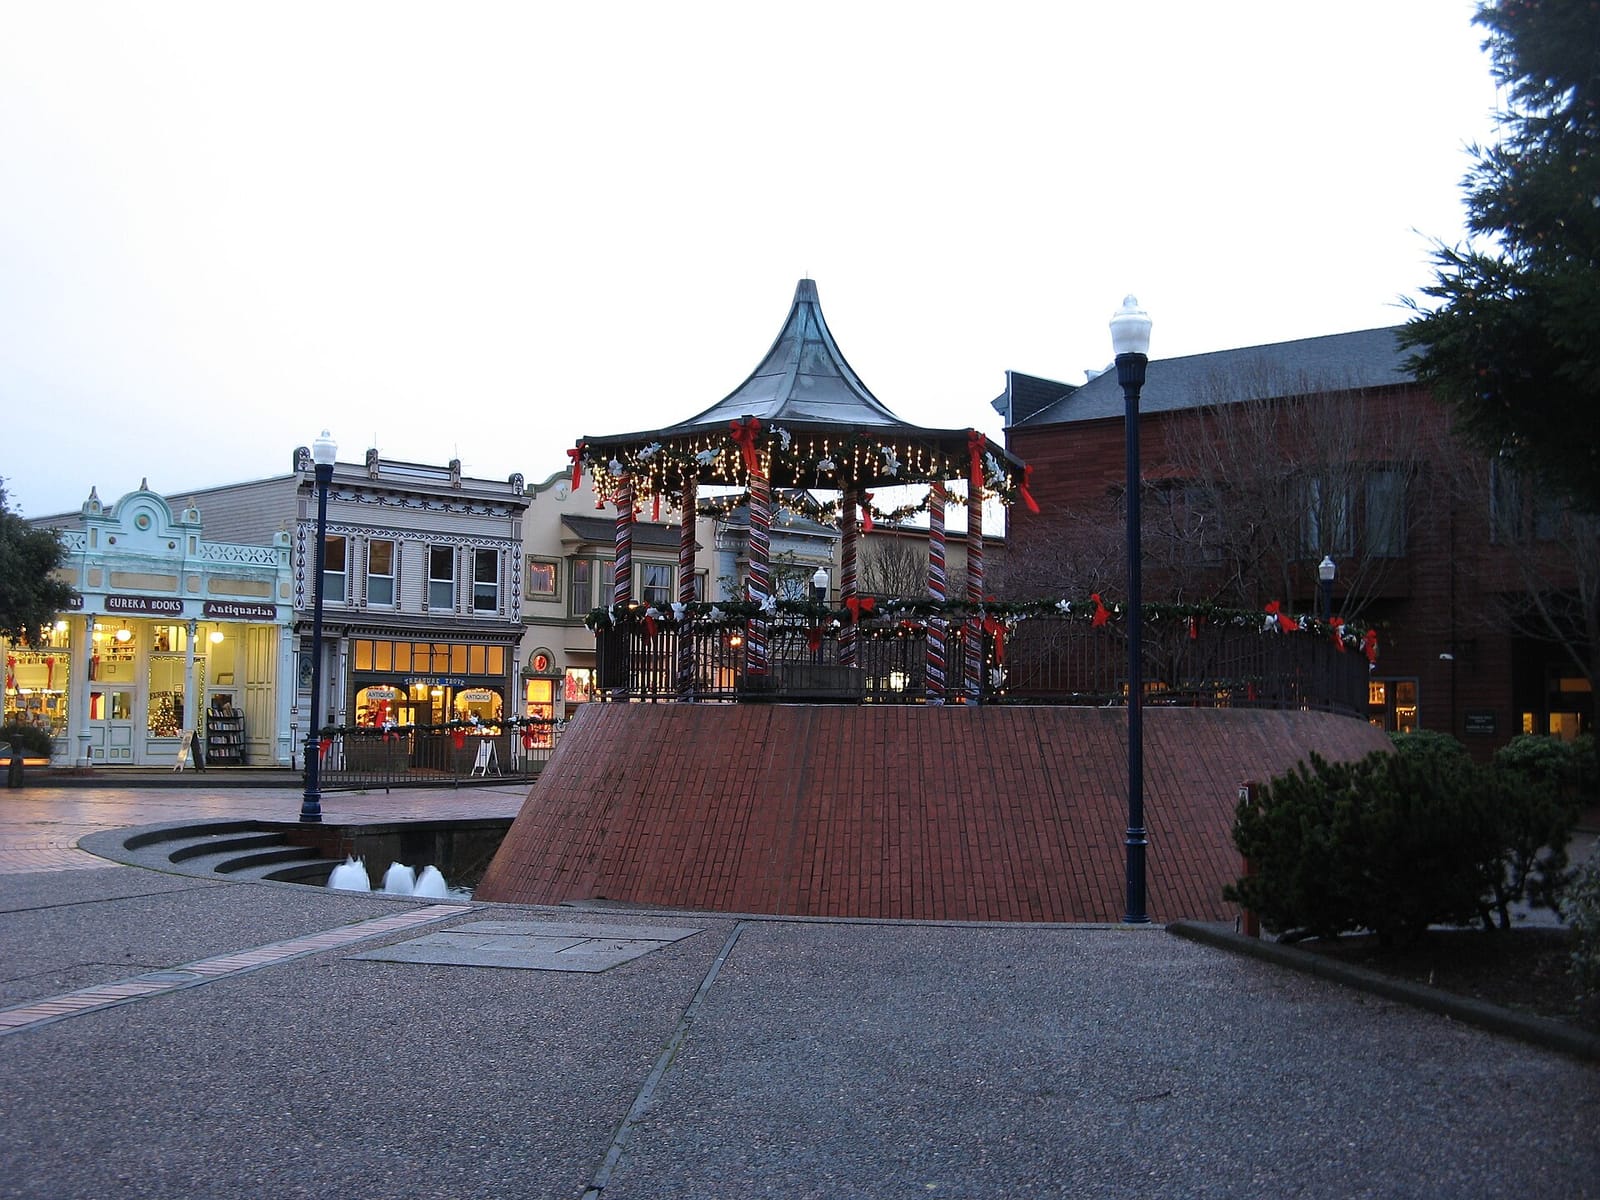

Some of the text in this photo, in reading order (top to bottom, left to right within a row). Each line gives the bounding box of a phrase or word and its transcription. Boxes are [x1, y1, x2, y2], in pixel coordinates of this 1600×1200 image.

[109, 598, 181, 611] EUREKA BOOKS
[208, 604, 274, 616] Antiquarian
